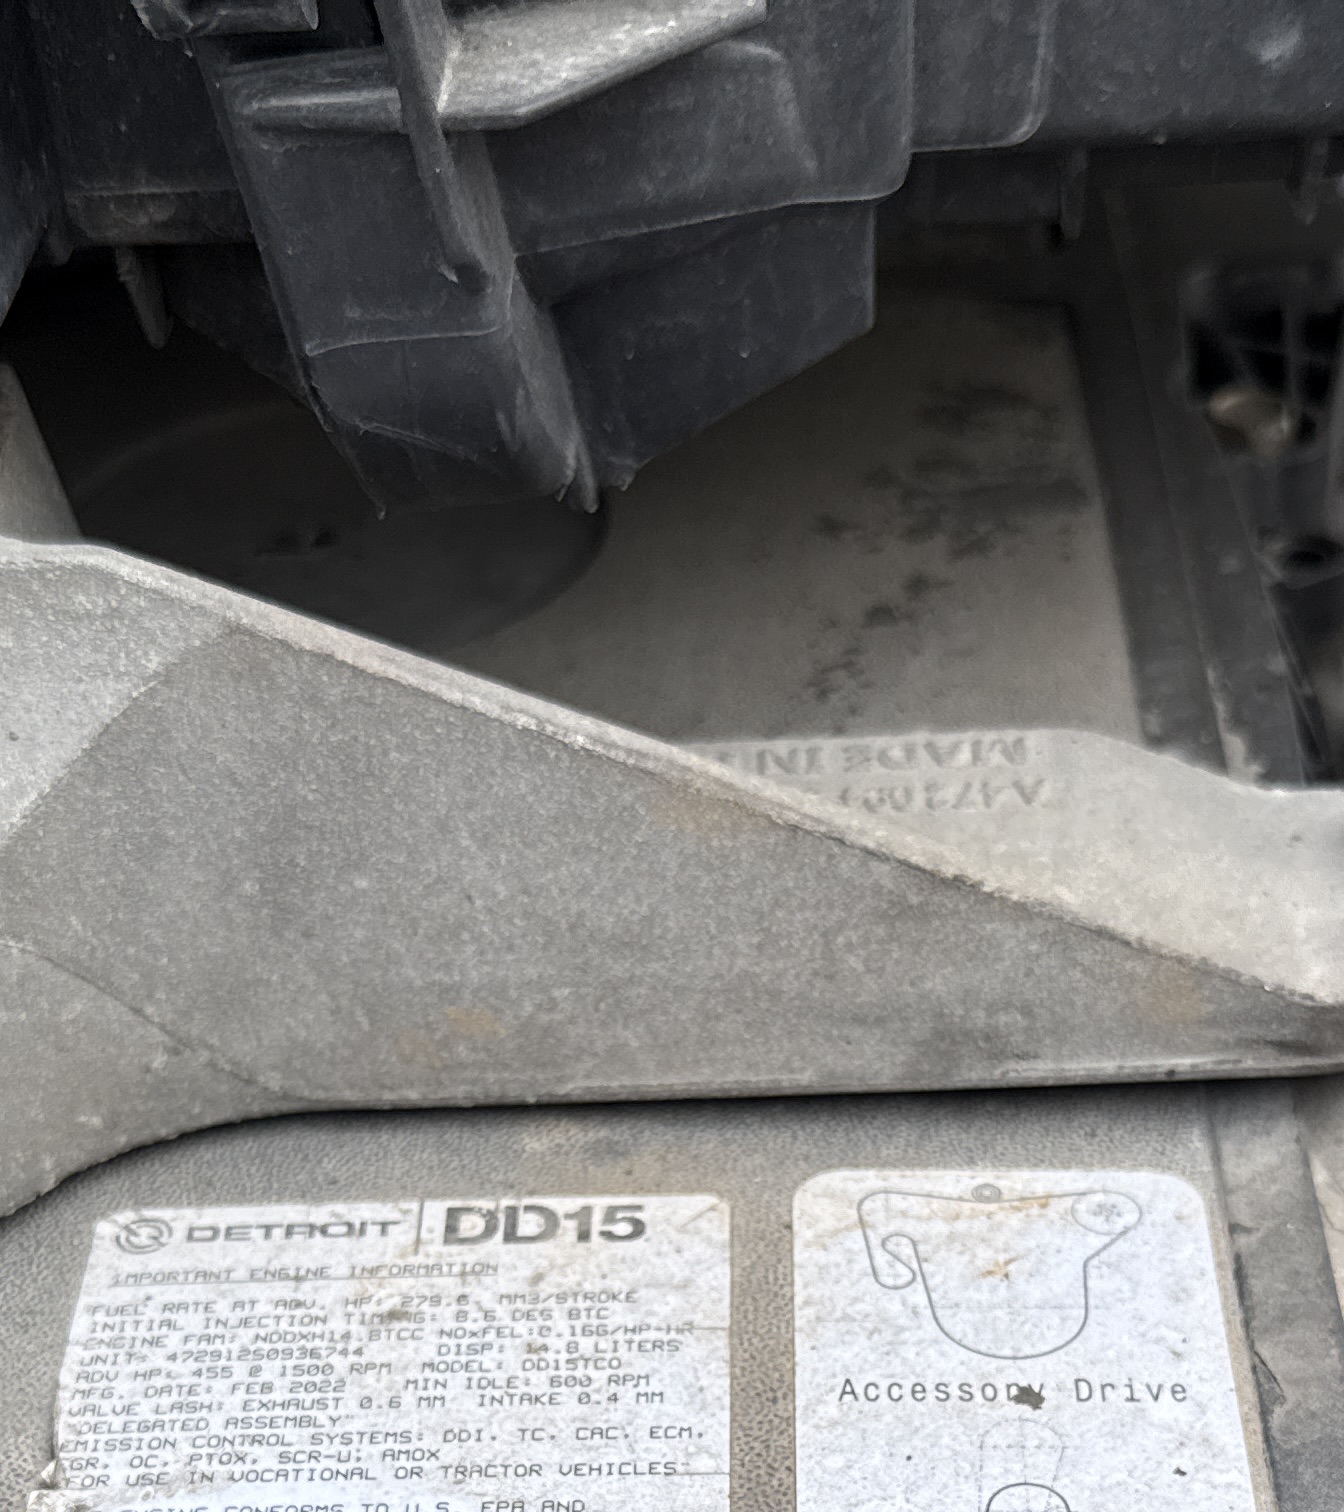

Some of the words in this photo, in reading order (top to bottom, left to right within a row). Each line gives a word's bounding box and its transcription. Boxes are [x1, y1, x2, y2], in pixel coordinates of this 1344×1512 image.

[185, 1219, 401, 1244] DETROIT
[443, 1204, 647, 1246] DD15
[113, 1268, 235, 1285] IMPORTANT
[249, 1266, 331, 1281] ENGINE
[349, 1261, 498, 1278] INFORMATION
[91, 1301, 147, 1316] FUEL
[160, 1299, 217, 1314] RATE
[231, 1297, 259, 1312] AT
[400, 1292, 470, 1307] 279.6
[499, 1288, 638, 1305] MM3/STROKE
[90, 1317, 184, 1333] INITIAL
[204, 1313, 328, 1329] INJECTION
[568, 1305, 609, 1320] BTC
[182, 1331, 236, 1346] FAM:
[437, 1341, 504, 1356] DISP:
[525, 1340, 579, 1355] 14.8
[593, 1338, 680, 1353] LITERS
[75, 1369, 118, 1383] ADV
[191, 1365, 233, 1379] 455
[248, 1364, 263, 1378] @
[279, 1362, 334, 1377] 1500
[347, 1361, 392, 1375] RPM
[421, 1358, 503, 1374] MODEL:
[71, 1385, 124, 1400] MFG.
[144, 1383, 212, 1398] DATE:
[230, 1381, 274, 1395] FEB
[289, 1379, 346, 1393] 2022
[404, 1377, 448, 1391] MIN
[465, 1375, 530, 1390] IDLE:
[549, 1374, 592, 1388] 600
[607, 1373, 650, 1387] RPM
[1074, 1377, 1188, 1402] Drive
[67, 1402, 140, 1417] VALVE
[155, 1400, 223, 1415] LASH:
[242, 1396, 344, 1412] EXHAUST
[358, 1395, 402, 1409] 0.6
[416, 1395, 446, 1409] MM
[478, 1391, 561, 1407] INTAKE
[577, 1390, 619, 1405] 0.4
[635, 1390, 664, 1404] MM
[59, 1436, 177, 1452] EMISSION
[191, 1433, 294, 1448] CONTROL
[310, 1430, 423, 1445] SYSTEMS:
[381, 1447, 440, 1462] AMOX
[63, 1473, 110, 1487] FOR
[125, 1472, 170, 1486] USE
[187, 1470, 214, 1484] IN
[229, 1466, 377, 1483] VOCATIONAL
[393, 1465, 424, 1479] OR
[441, 1463, 542, 1478] TRACTOR
[540, 1499, 585, 1512] AND
